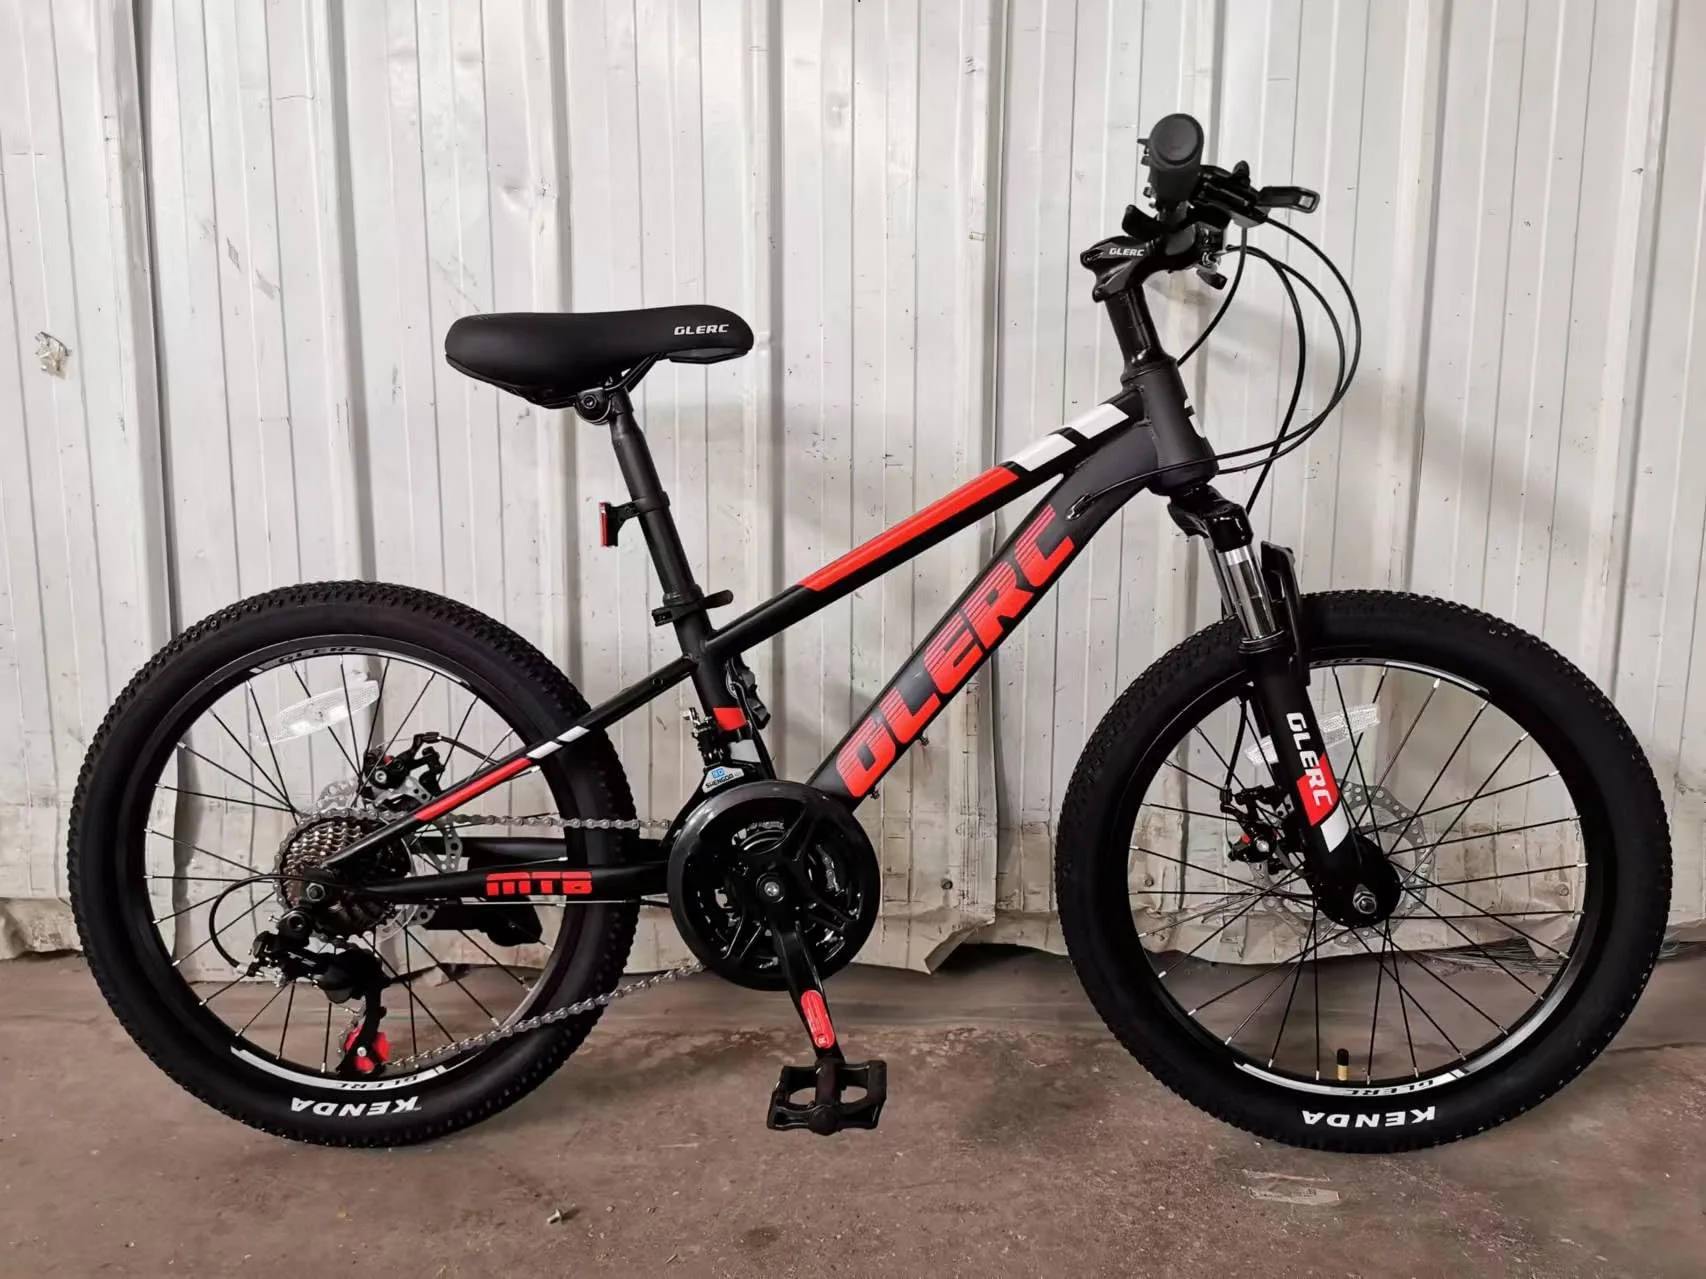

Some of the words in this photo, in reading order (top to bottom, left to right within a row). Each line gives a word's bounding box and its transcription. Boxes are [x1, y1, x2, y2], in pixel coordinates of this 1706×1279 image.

[1109, 247, 1145, 256] GLERC
[673, 324, 729, 335] GLERC
[836, 504, 1074, 797] GLERC
[1286, 712, 1334, 806] GLERC
[486, 871, 592, 896] MTB
[290, 1096, 418, 1117] KENDA
[1302, 1105, 1436, 1128] KENDA
